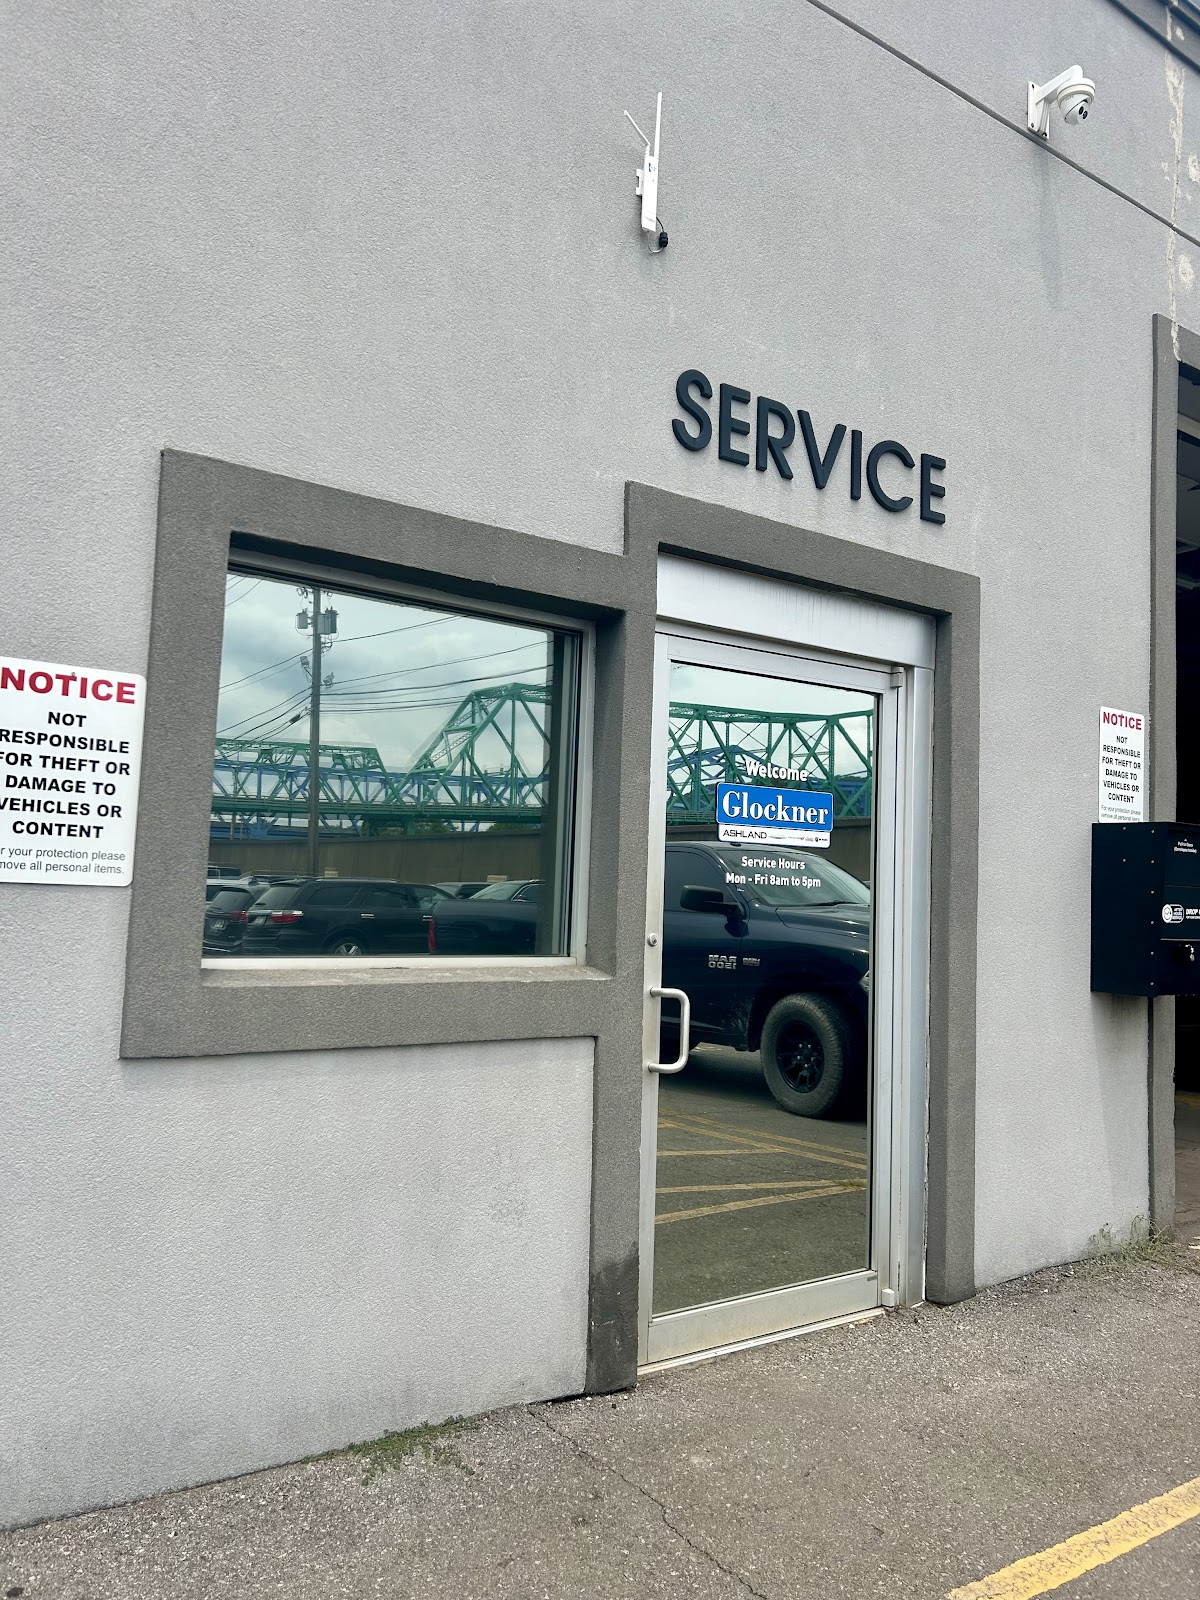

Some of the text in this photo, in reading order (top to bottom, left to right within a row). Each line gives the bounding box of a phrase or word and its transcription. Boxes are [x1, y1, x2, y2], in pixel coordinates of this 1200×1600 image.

[672, 369, 946, 525] SERVICE
[1, 667, 136, 704] NOTICE
[48, 711, 87, 727] NOT
[1103, 711, 1142, 730] NOTICE
[0, 728, 130, 754] RESPONSIBLE
[1116, 735, 1128, 744] NOT
[1103, 744, 1141, 758] RESPONSIBLE
[39, 755, 100, 773] THEFT
[105, 761, 130, 775] OR
[745, 759, 808, 782] Welcome
[1102, 756, 1141, 770] FOR THEFT OR
[1105, 769, 1138, 780] DAMAGE TO
[5, 774, 117, 796] DAMAGE TO
[1103, 780, 1139, 792] VEHICLES OR
[1108, 792, 1134, 803] CONTENT
[0, 797, 122, 818] VEHICLES OR
[722, 790, 829, 825] Glockner
[12, 820, 104, 839] CONTENT
[722, 829, 767, 839] ASHLAND
[8, 848, 33, 857] your
[35, 848, 89, 859] protection
[91, 851, 126, 861] please
[29, 861, 42, 870] all
[45, 863, 91, 873] personal
[94, 863, 125, 874] items.
[741, 856, 806, 870] Service Hours
[725, 872, 746, 884] Mon
[754, 873, 768, 885] Fri
[769, 875, 789, 886] 8am
[791, 875, 800, 886] to
[802, 876, 821, 889] 5pm
